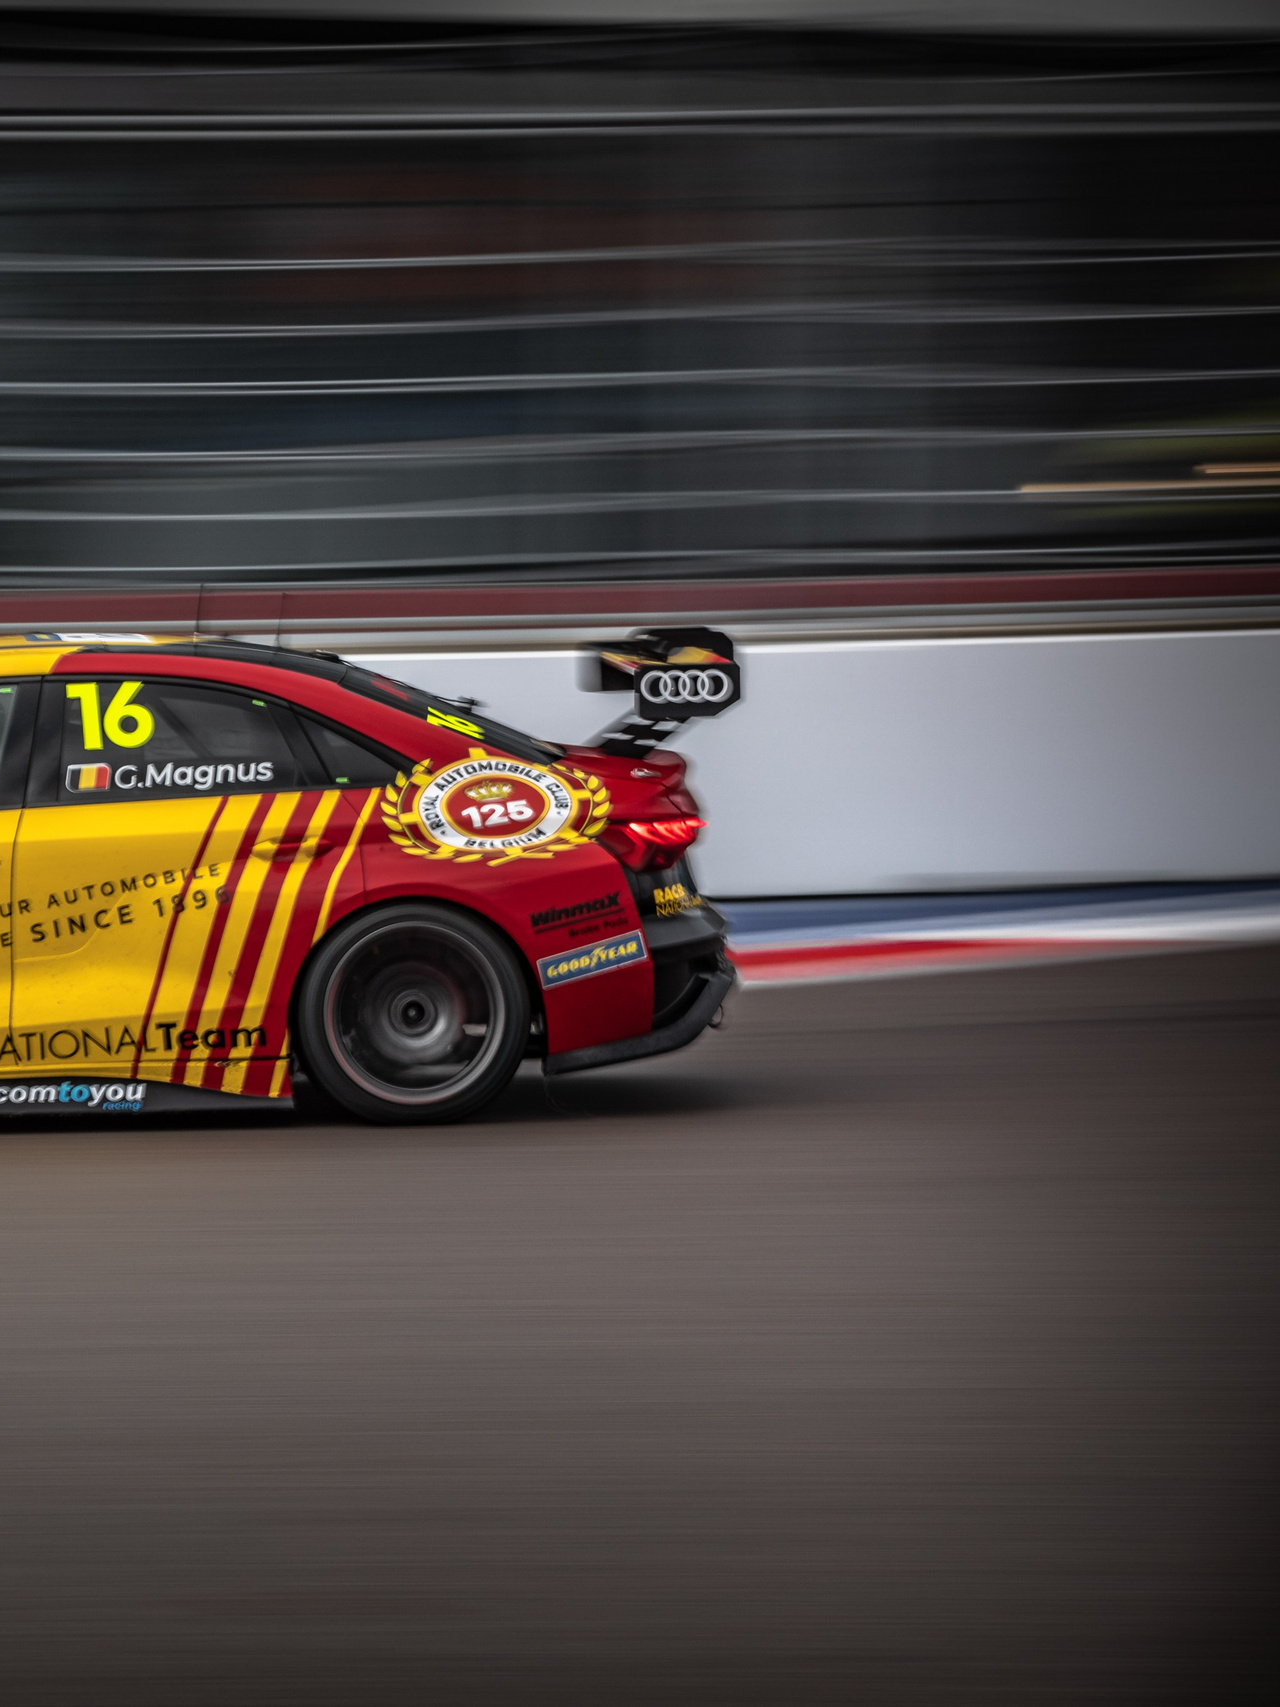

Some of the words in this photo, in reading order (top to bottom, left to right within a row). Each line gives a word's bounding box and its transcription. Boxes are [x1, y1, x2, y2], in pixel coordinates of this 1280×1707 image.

[66, 681, 155, 750] 16
[427, 706, 485, 740] 16
[114, 761, 274, 790] G.Magnus
[422, 794, 445, 831] ROYAL
[435, 761, 546, 792] AUTOMOBILE
[545, 782, 570, 810] CLUB
[461, 799, 534, 829] 125
[464, 827, 547, 849] BELGIUM
[47, 863, 220, 909] AUTOMOBILE
[653, 883, 685, 904] RACB
[30, 904, 133, 943] SINCE
[152, 884, 231, 918] 1896
[102, 1101, 144, 1112] racing
